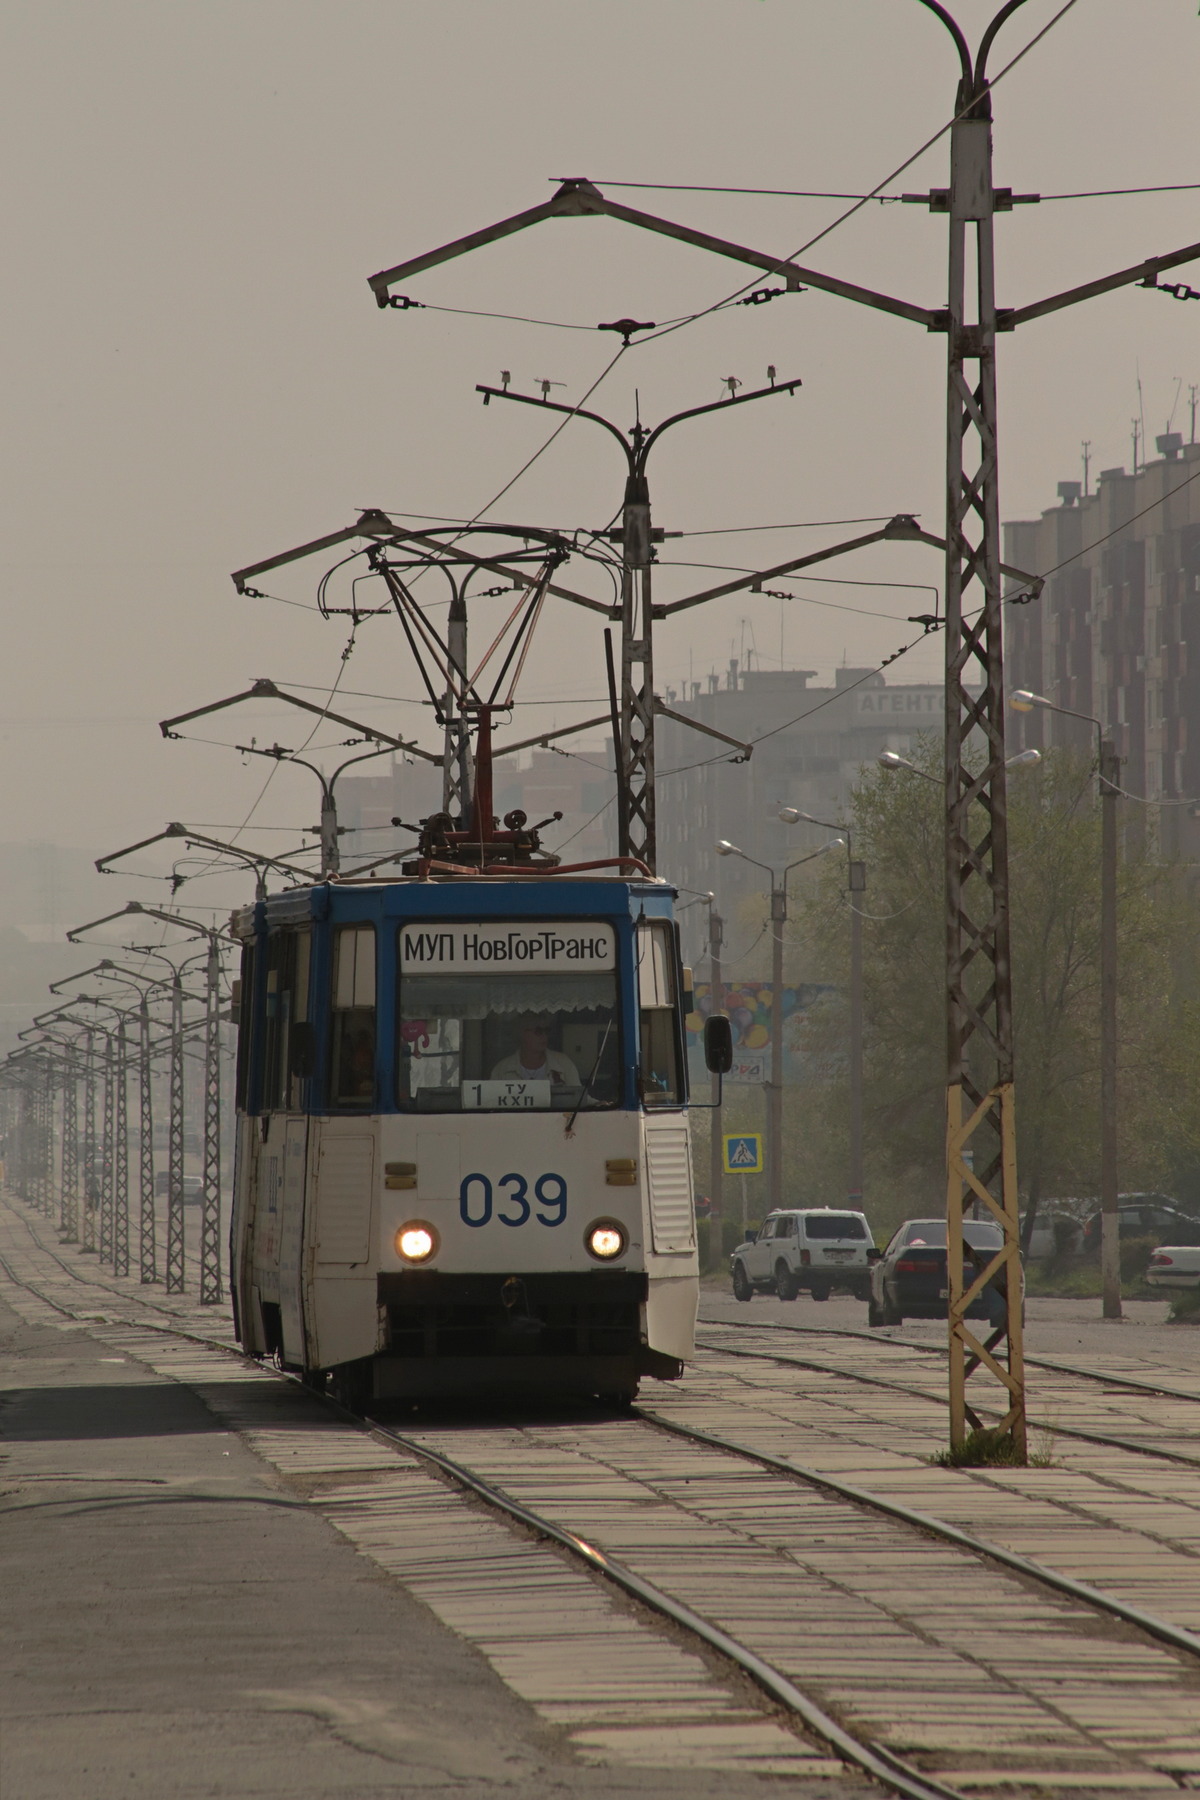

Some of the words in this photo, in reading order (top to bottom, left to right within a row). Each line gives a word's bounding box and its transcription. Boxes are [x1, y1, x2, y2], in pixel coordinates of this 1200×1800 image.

[404, 933, 454, 961] МУП
[463, 932, 608, 961] НовГорТранс
[472, 1083, 482, 1106] 1
[505, 1083, 527, 1095] ТУ
[498, 1096, 534, 1107] КХП
[460, 1173, 567, 1228] 039
